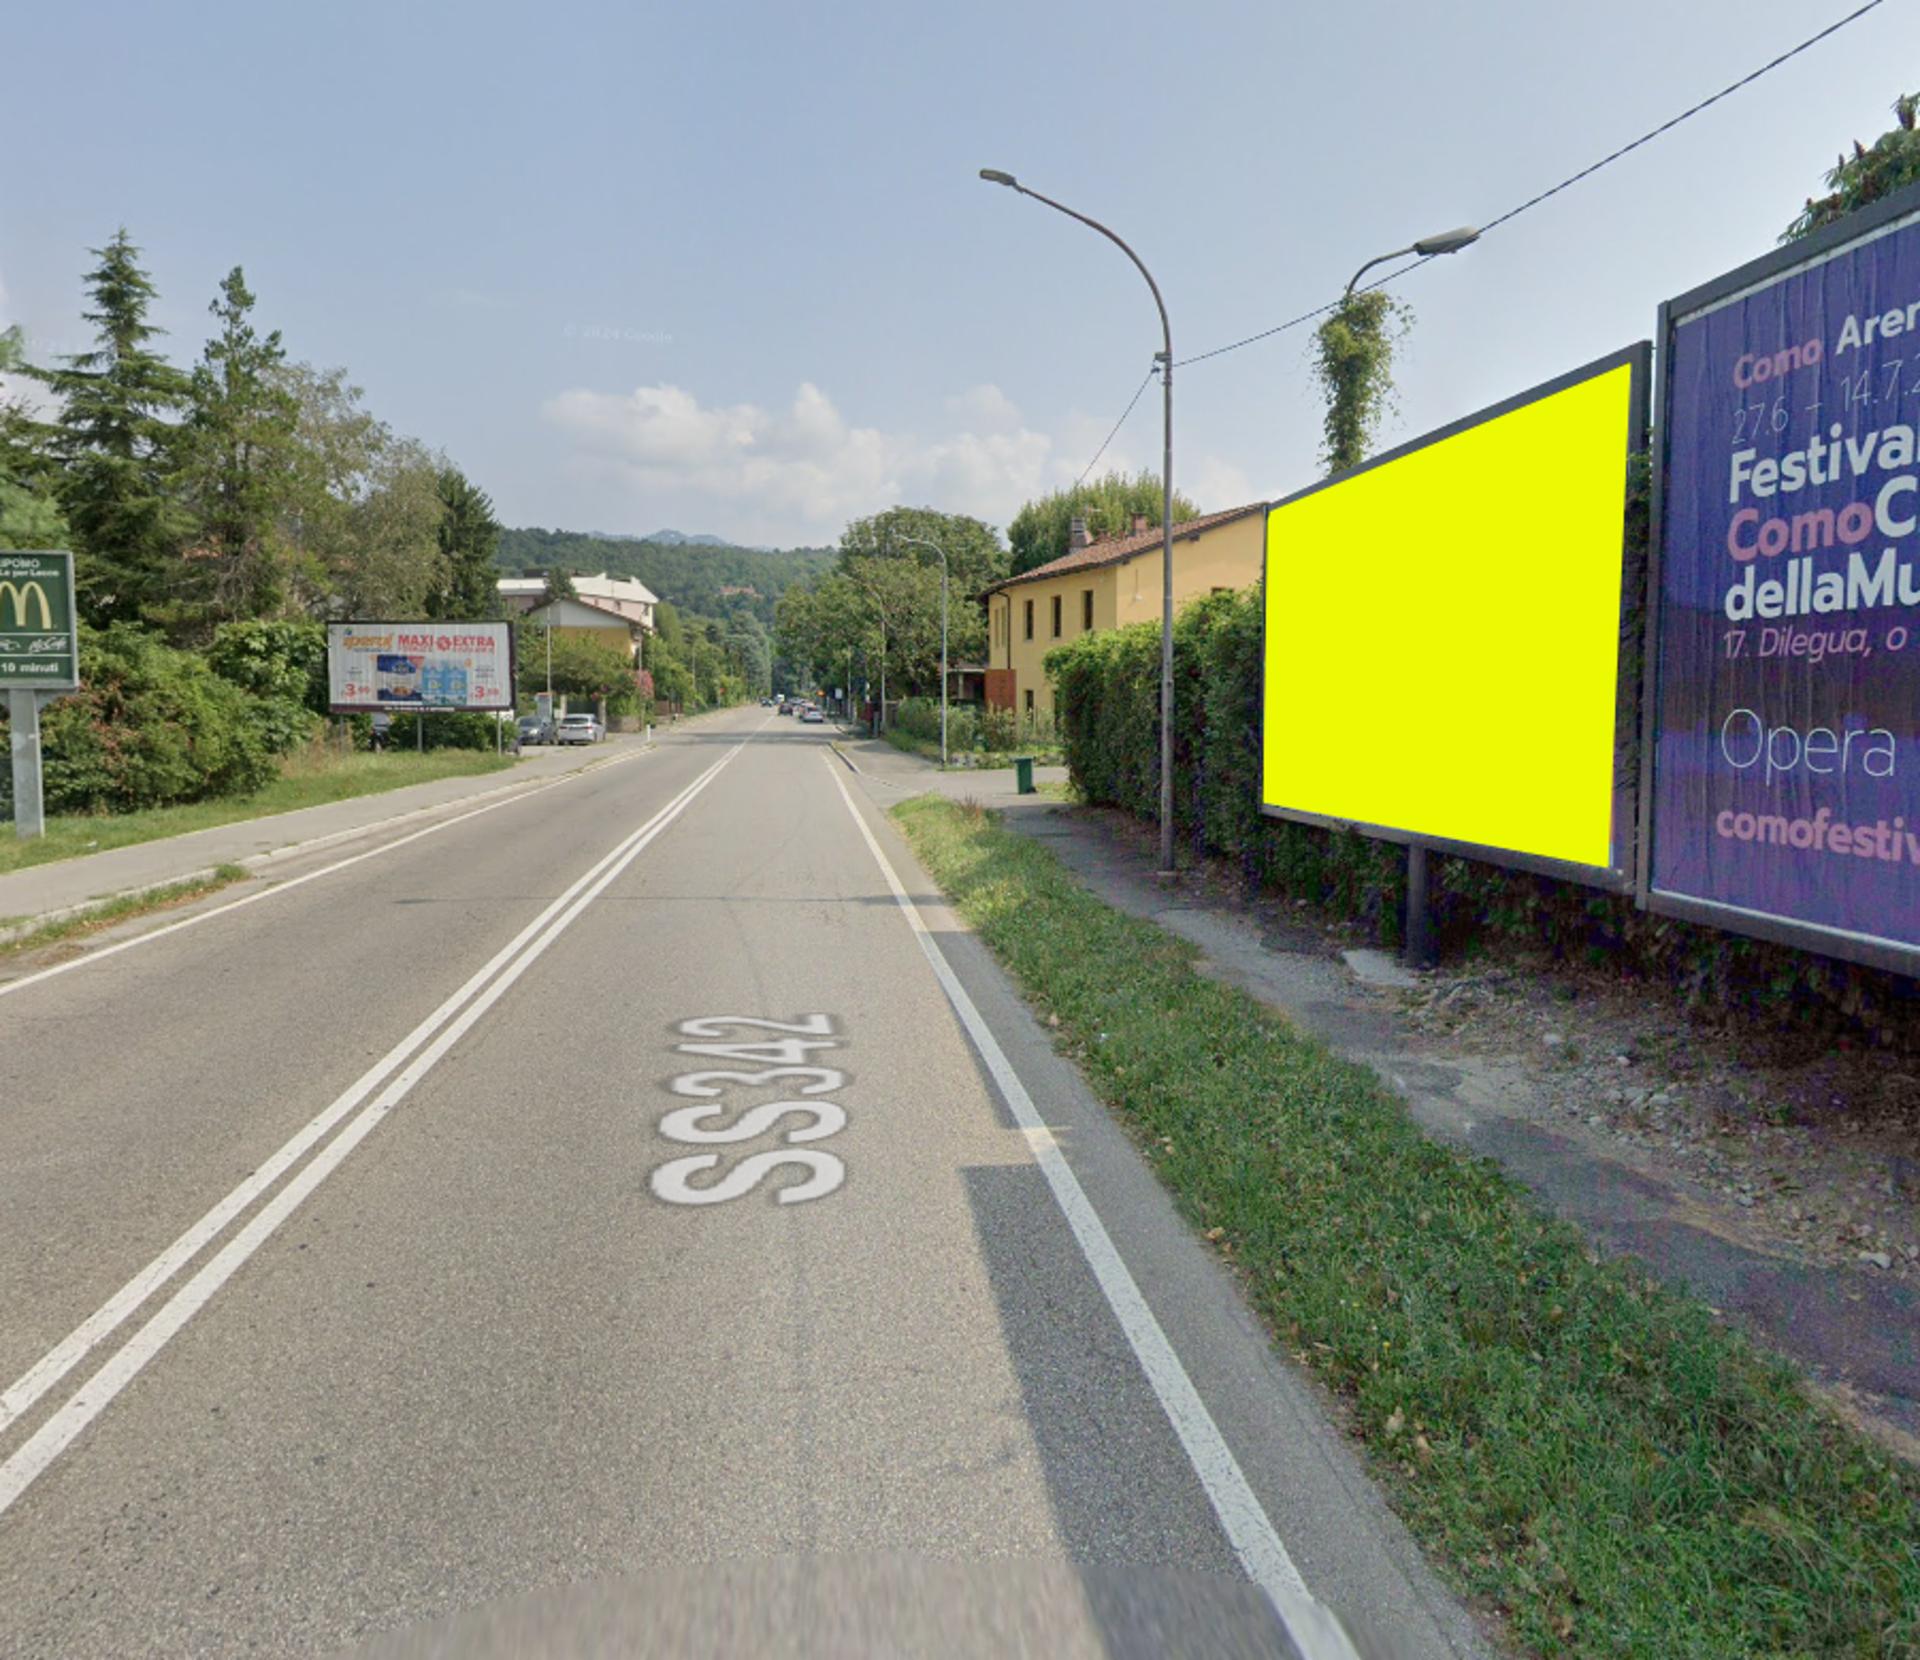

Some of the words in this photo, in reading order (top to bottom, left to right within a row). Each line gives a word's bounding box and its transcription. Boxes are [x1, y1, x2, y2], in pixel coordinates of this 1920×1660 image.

[1733, 338, 1823, 390] Como
[1731, 396, 1789, 445] 27.6
[1729, 422, 1920, 504] Festiva
[1724, 547, 1920, 621] dellaMu
[398, 634, 433, 647] MAXI
[452, 635, 495, 648] EXTRA
[1722, 631, 1750, 659] 17.
[1759, 624, 1873, 663] Dilegua,
[1885, 626, 1908, 650] o
[1722, 708, 1896, 786] Opera
